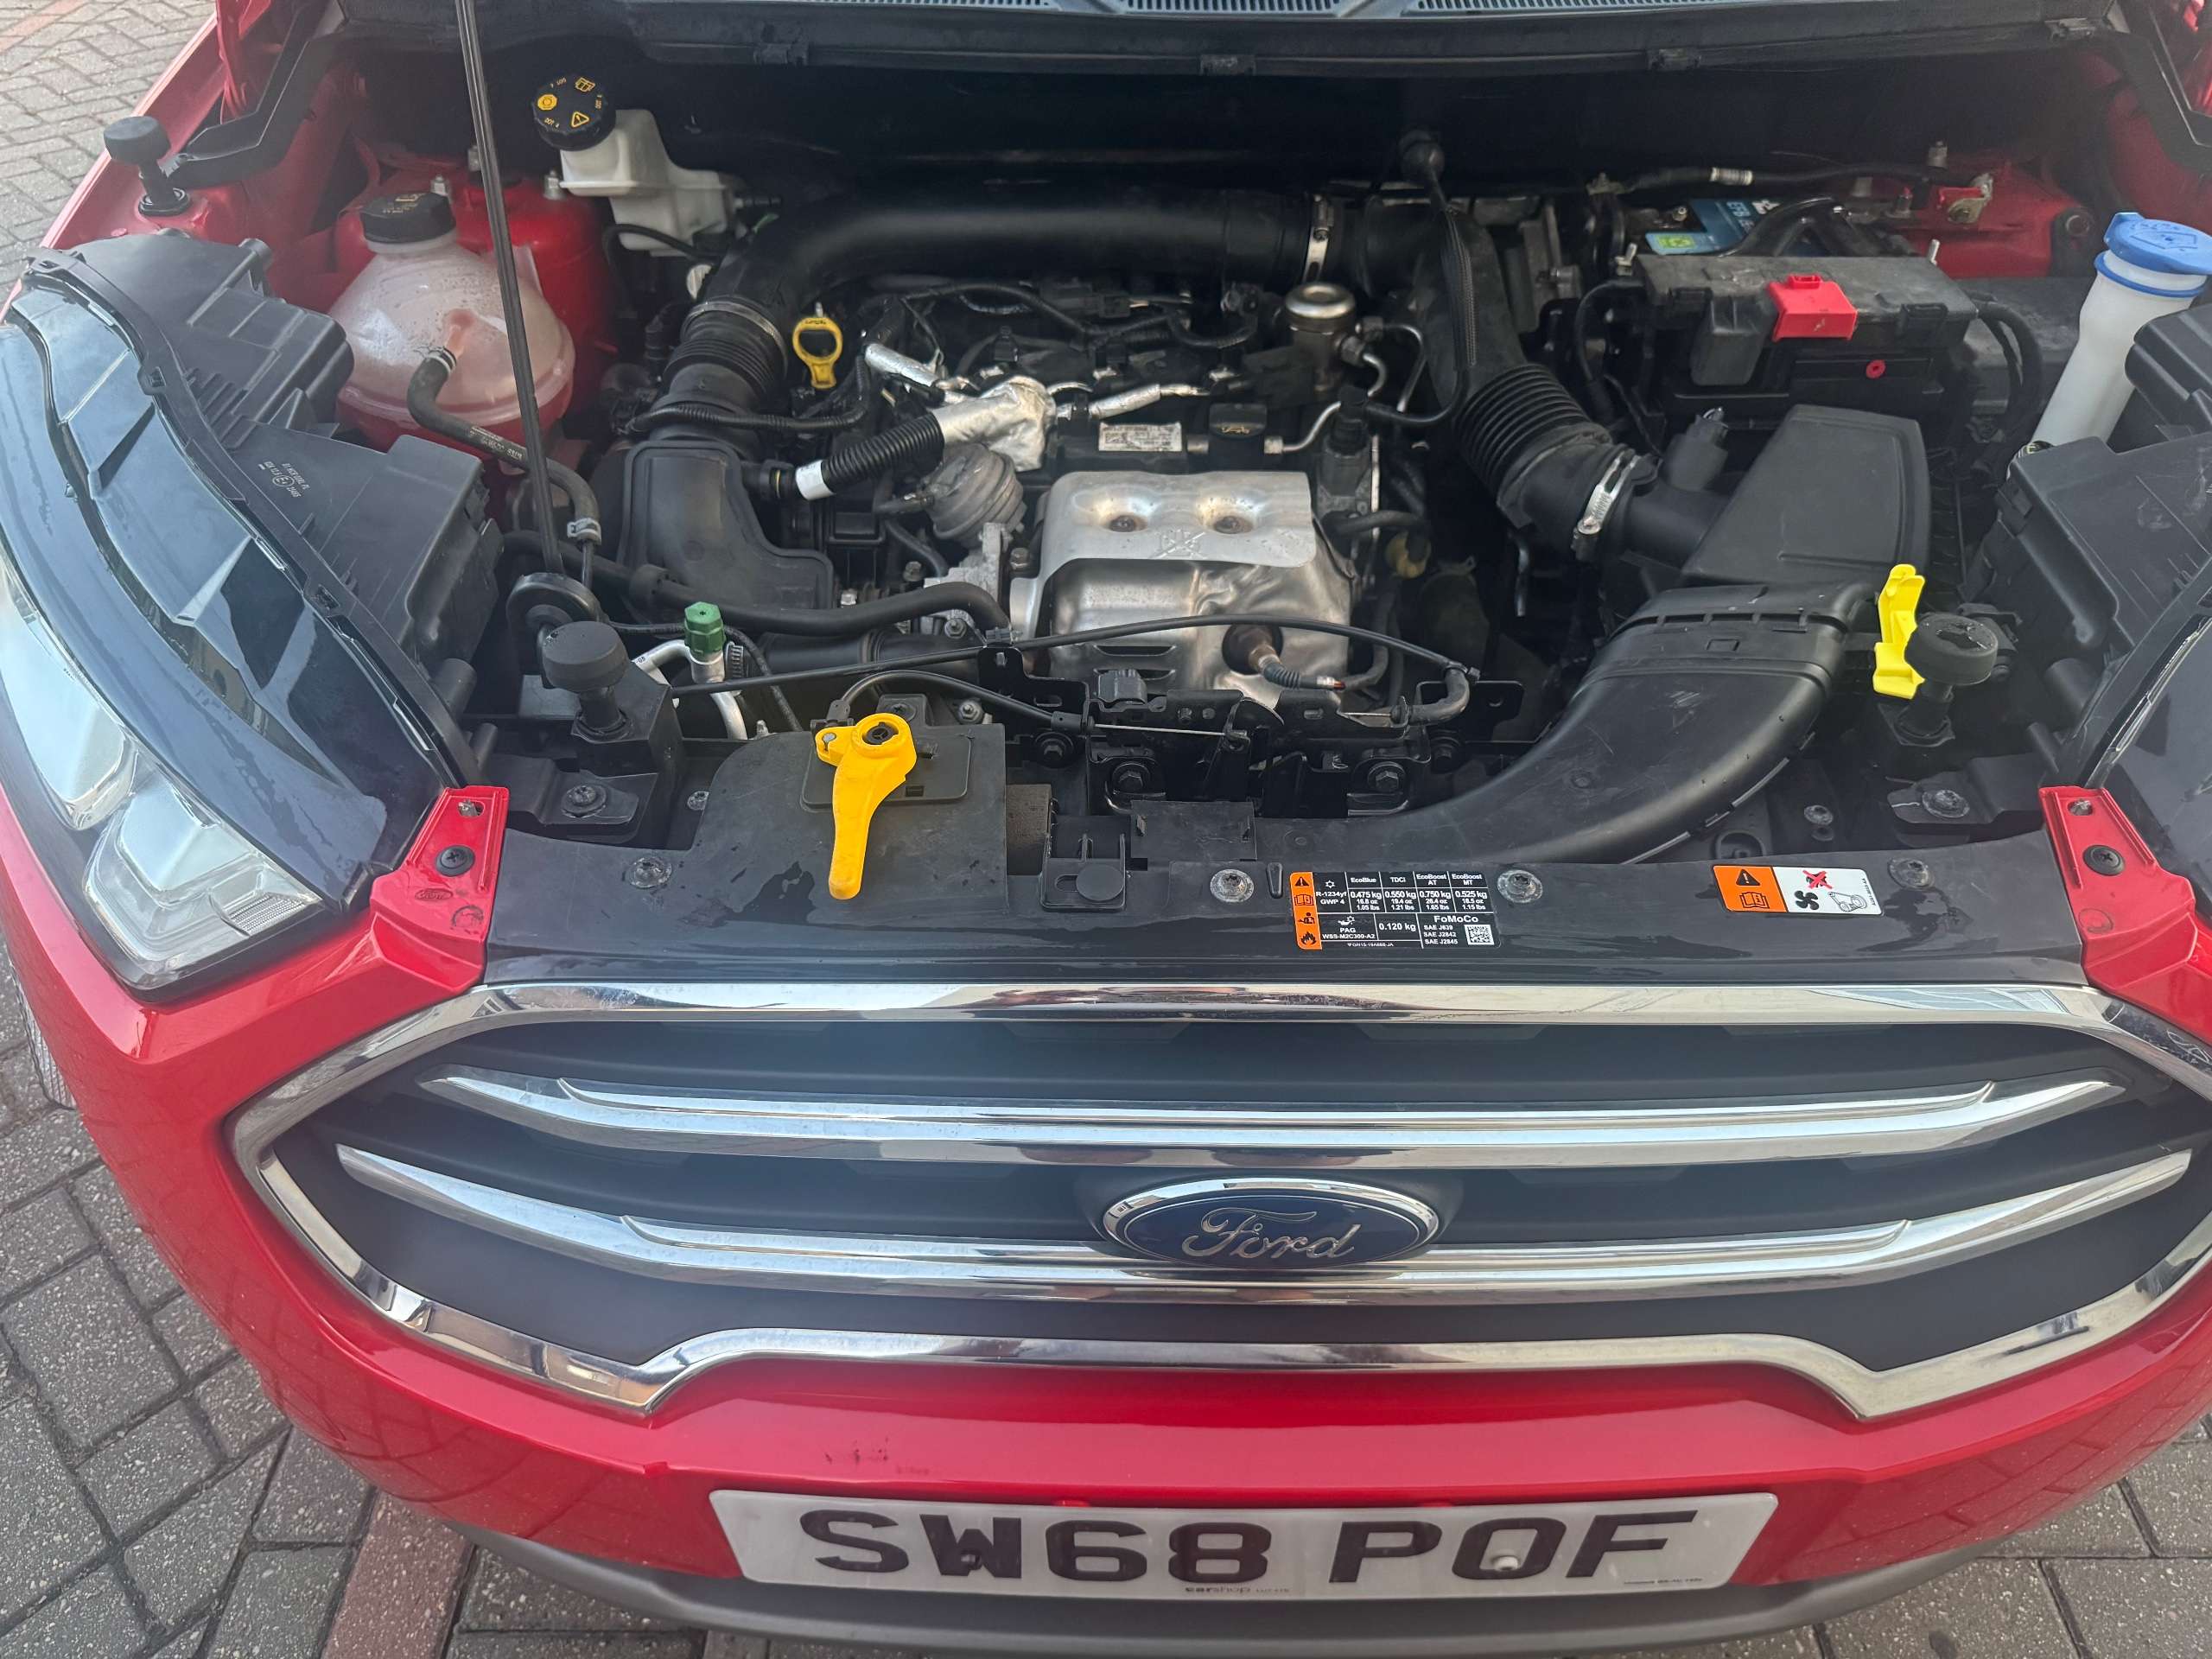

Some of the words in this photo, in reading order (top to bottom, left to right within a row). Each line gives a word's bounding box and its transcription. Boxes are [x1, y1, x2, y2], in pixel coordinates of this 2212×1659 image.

[1371, 891, 1382, 899] kg
[1406, 891, 1416, 899] kg
[1440, 891, 1452, 899] kg
[1477, 891, 1487, 899] kg
[1378, 922, 1402, 931] 0.120
[1404, 922, 1416, 931] kg
[1181, 1206, 1362, 1260] Ford
[799, 1510, 1272, 1583] SW68
[1328, 1510, 1700, 1583] POF
